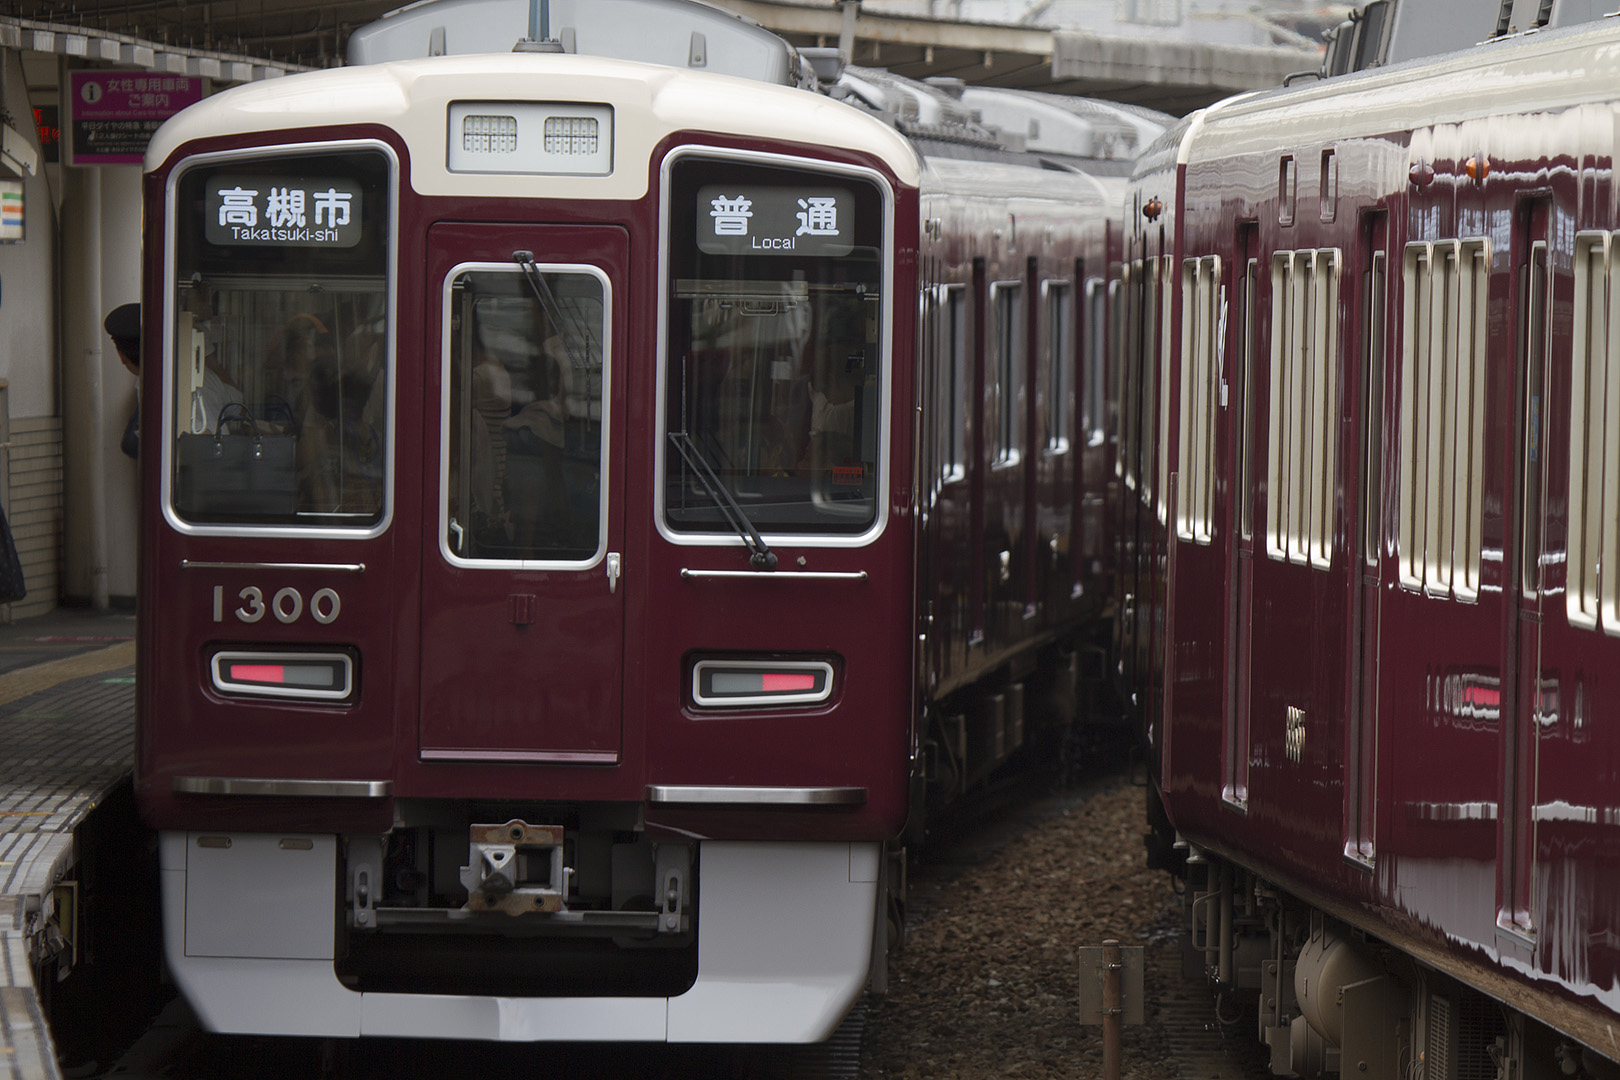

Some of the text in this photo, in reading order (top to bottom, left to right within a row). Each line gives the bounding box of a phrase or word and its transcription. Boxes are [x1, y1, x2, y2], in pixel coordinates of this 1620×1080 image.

[107, 78, 189, 92] 女性専用車両
[128, 94, 169, 107] ご案内
[218, 186, 352, 228] 高槻市
[709, 194, 840, 236] 普通
[231, 226, 339, 242] Takatsuki-shi
[752, 236, 795, 249] Local
[213, 585, 341, 625] 1300
